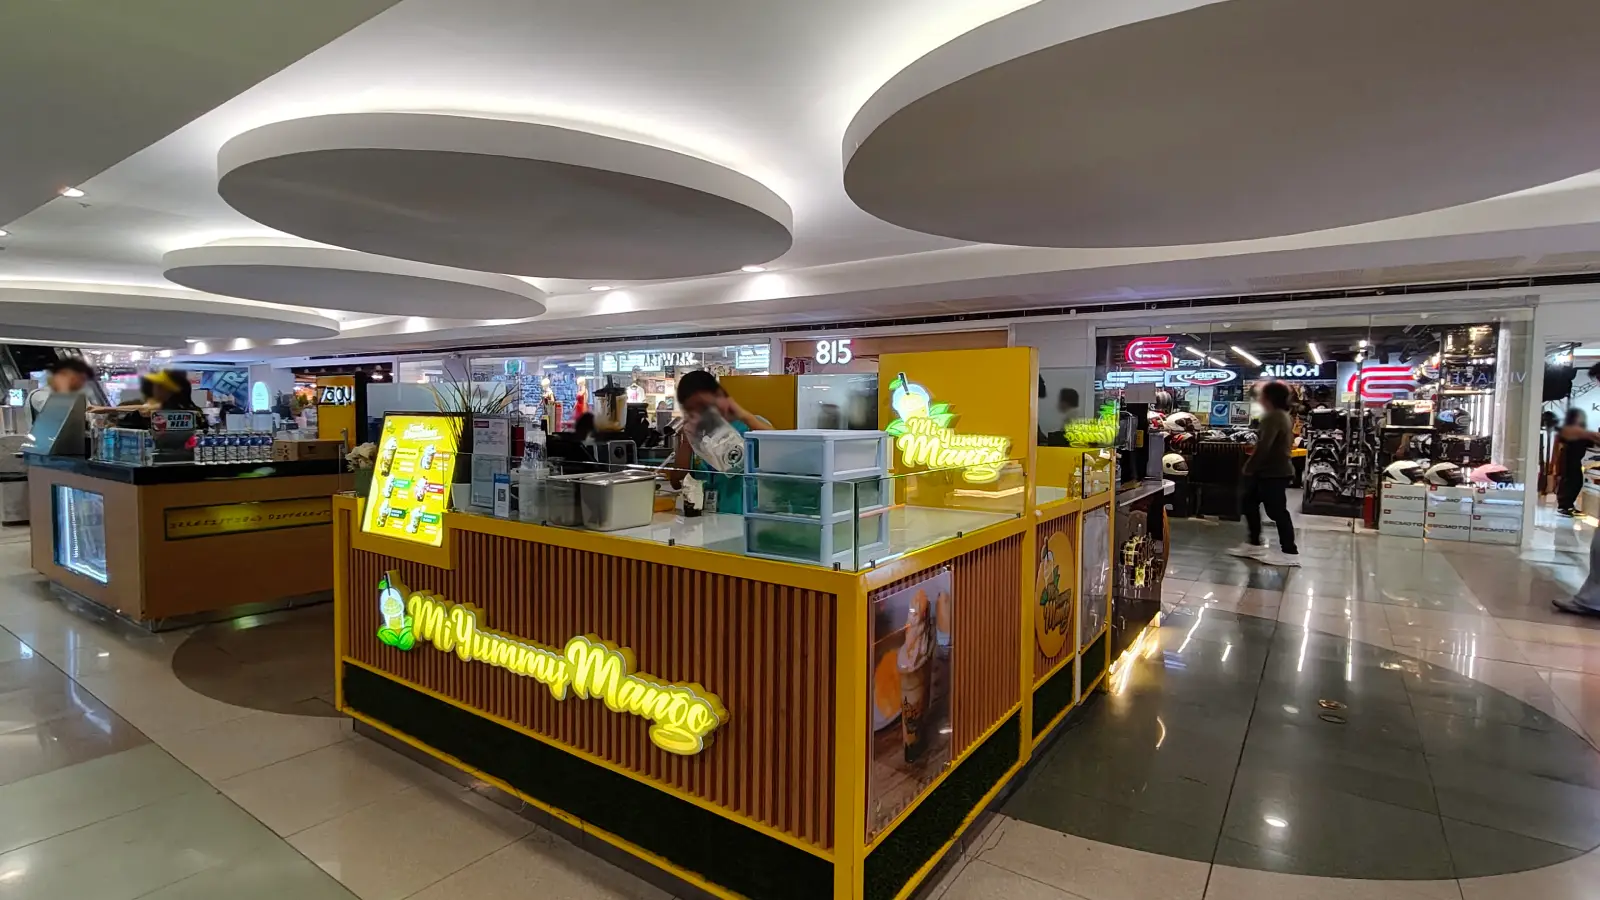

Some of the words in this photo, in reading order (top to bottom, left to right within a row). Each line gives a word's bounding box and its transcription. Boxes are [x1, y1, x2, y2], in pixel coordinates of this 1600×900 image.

[816, 340, 852, 364] 815
[908, 418, 937, 437] Mi
[938, 428, 1008, 450] Yummy
[897, 433, 1008, 482] Mango
[407, 595, 454, 652] Mi
[453, 608, 569, 700] Yummy
[566, 639, 718, 753] Mango
